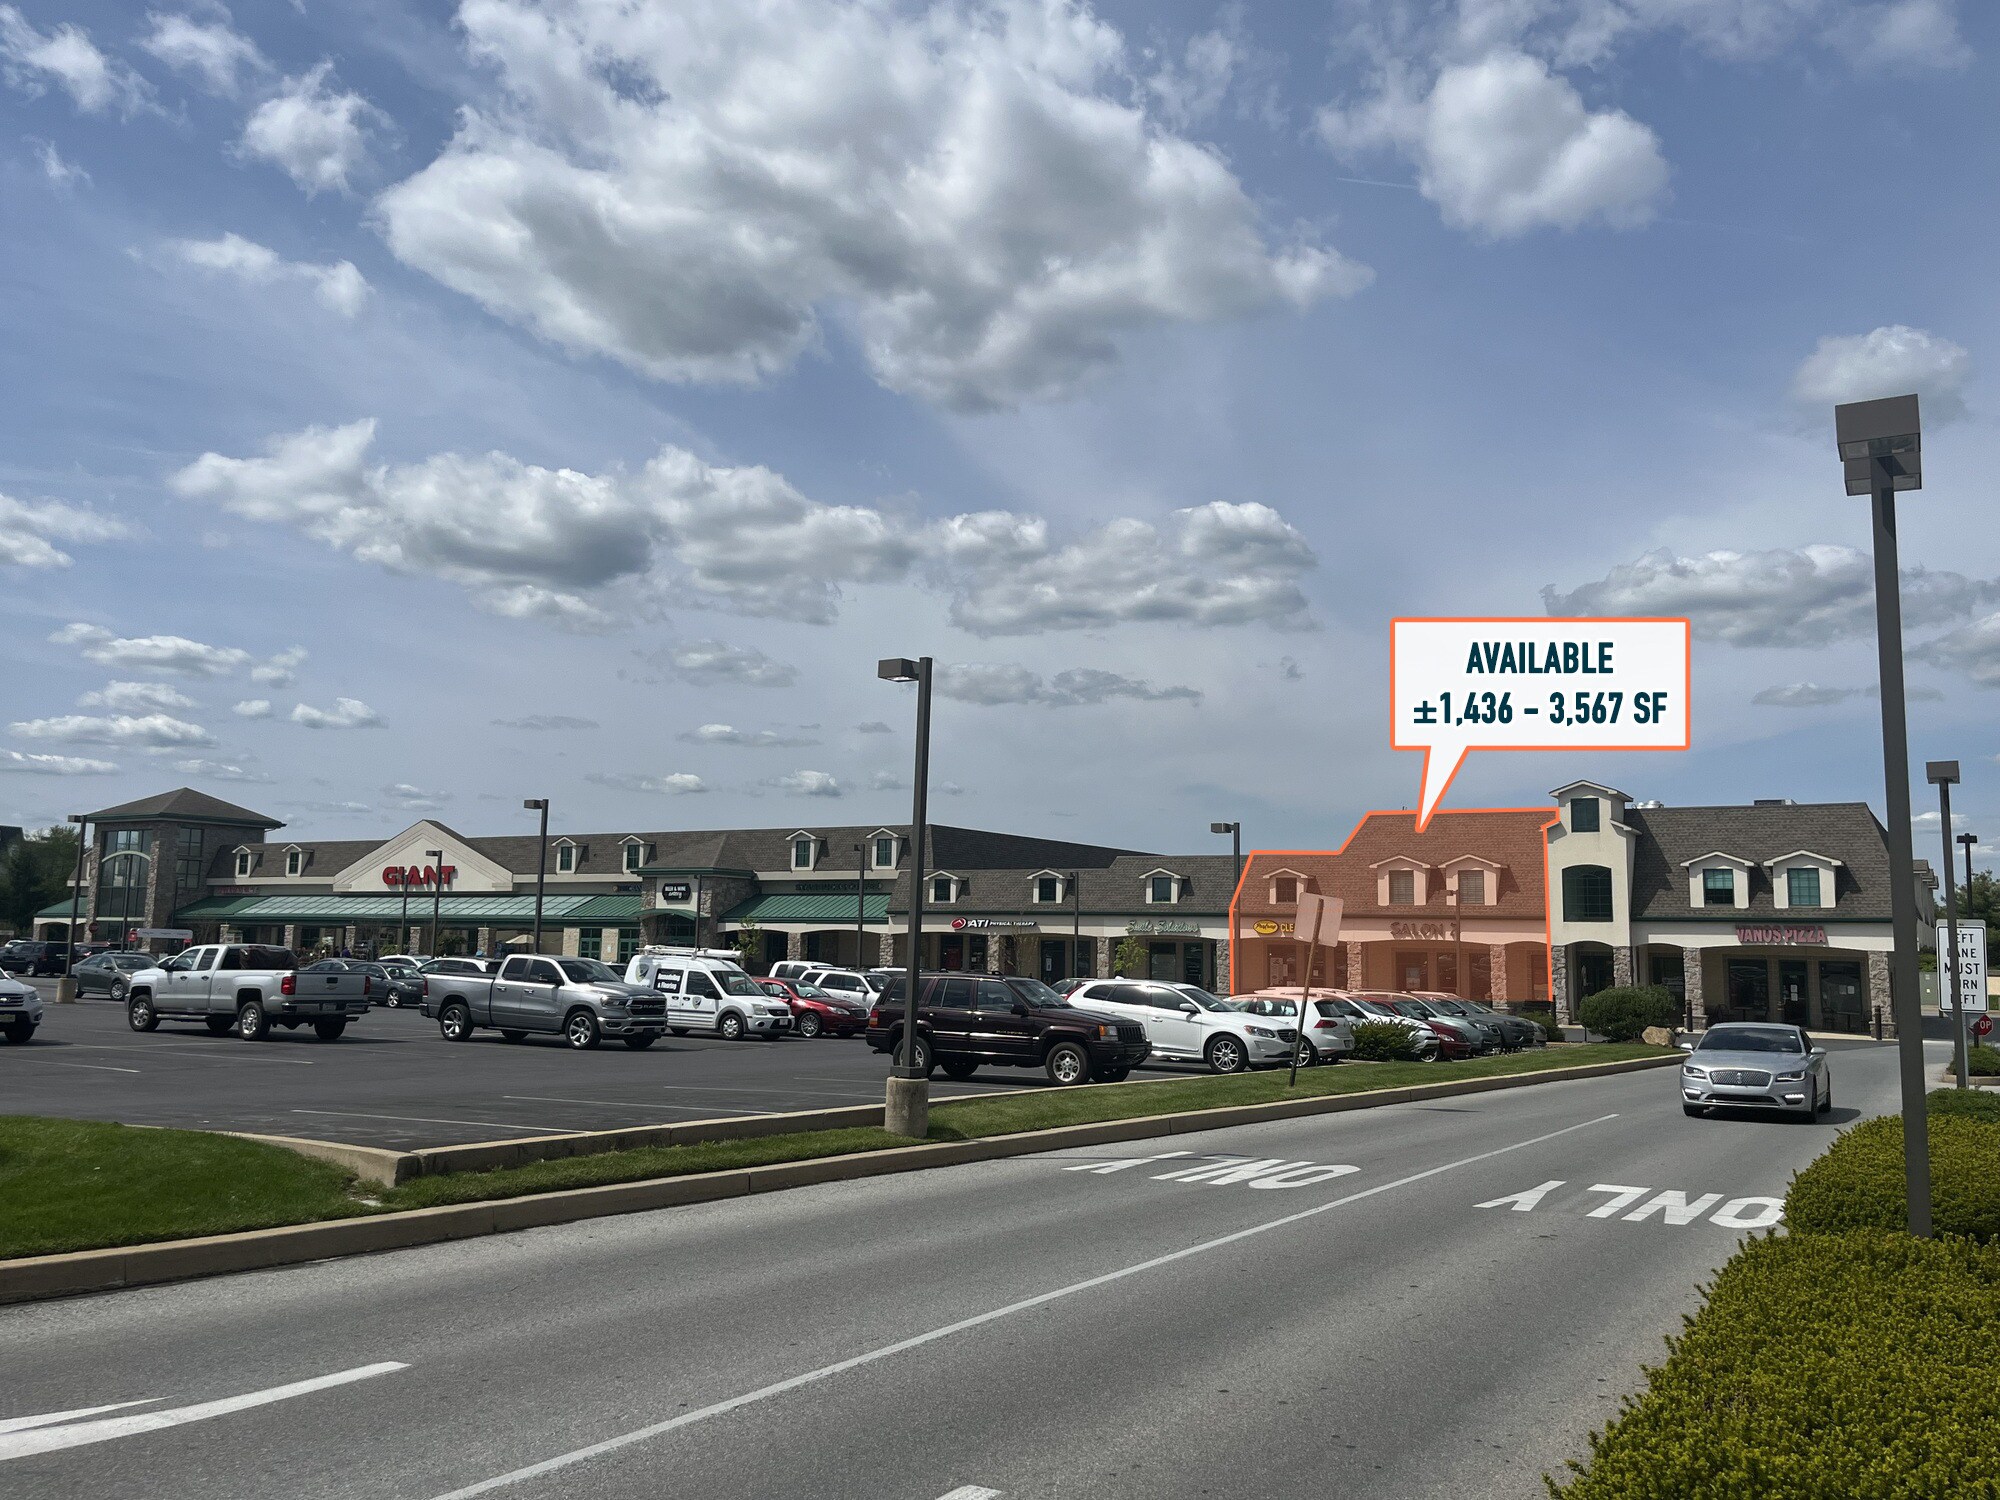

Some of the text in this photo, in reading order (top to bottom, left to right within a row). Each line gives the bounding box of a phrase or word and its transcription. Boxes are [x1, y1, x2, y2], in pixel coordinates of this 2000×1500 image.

[383, 865, 456, 885] GIANT
[1126, 920, 1198, 933] Smile Solutions
[1390, 922, 1444, 936] SALON
[1783, 926, 1827, 943] PIZZA
[1979, 1020, 1991, 1029] OP
[1060, 1151, 1361, 1189] ONLY
[1472, 1180, 1787, 1229] ONLY
